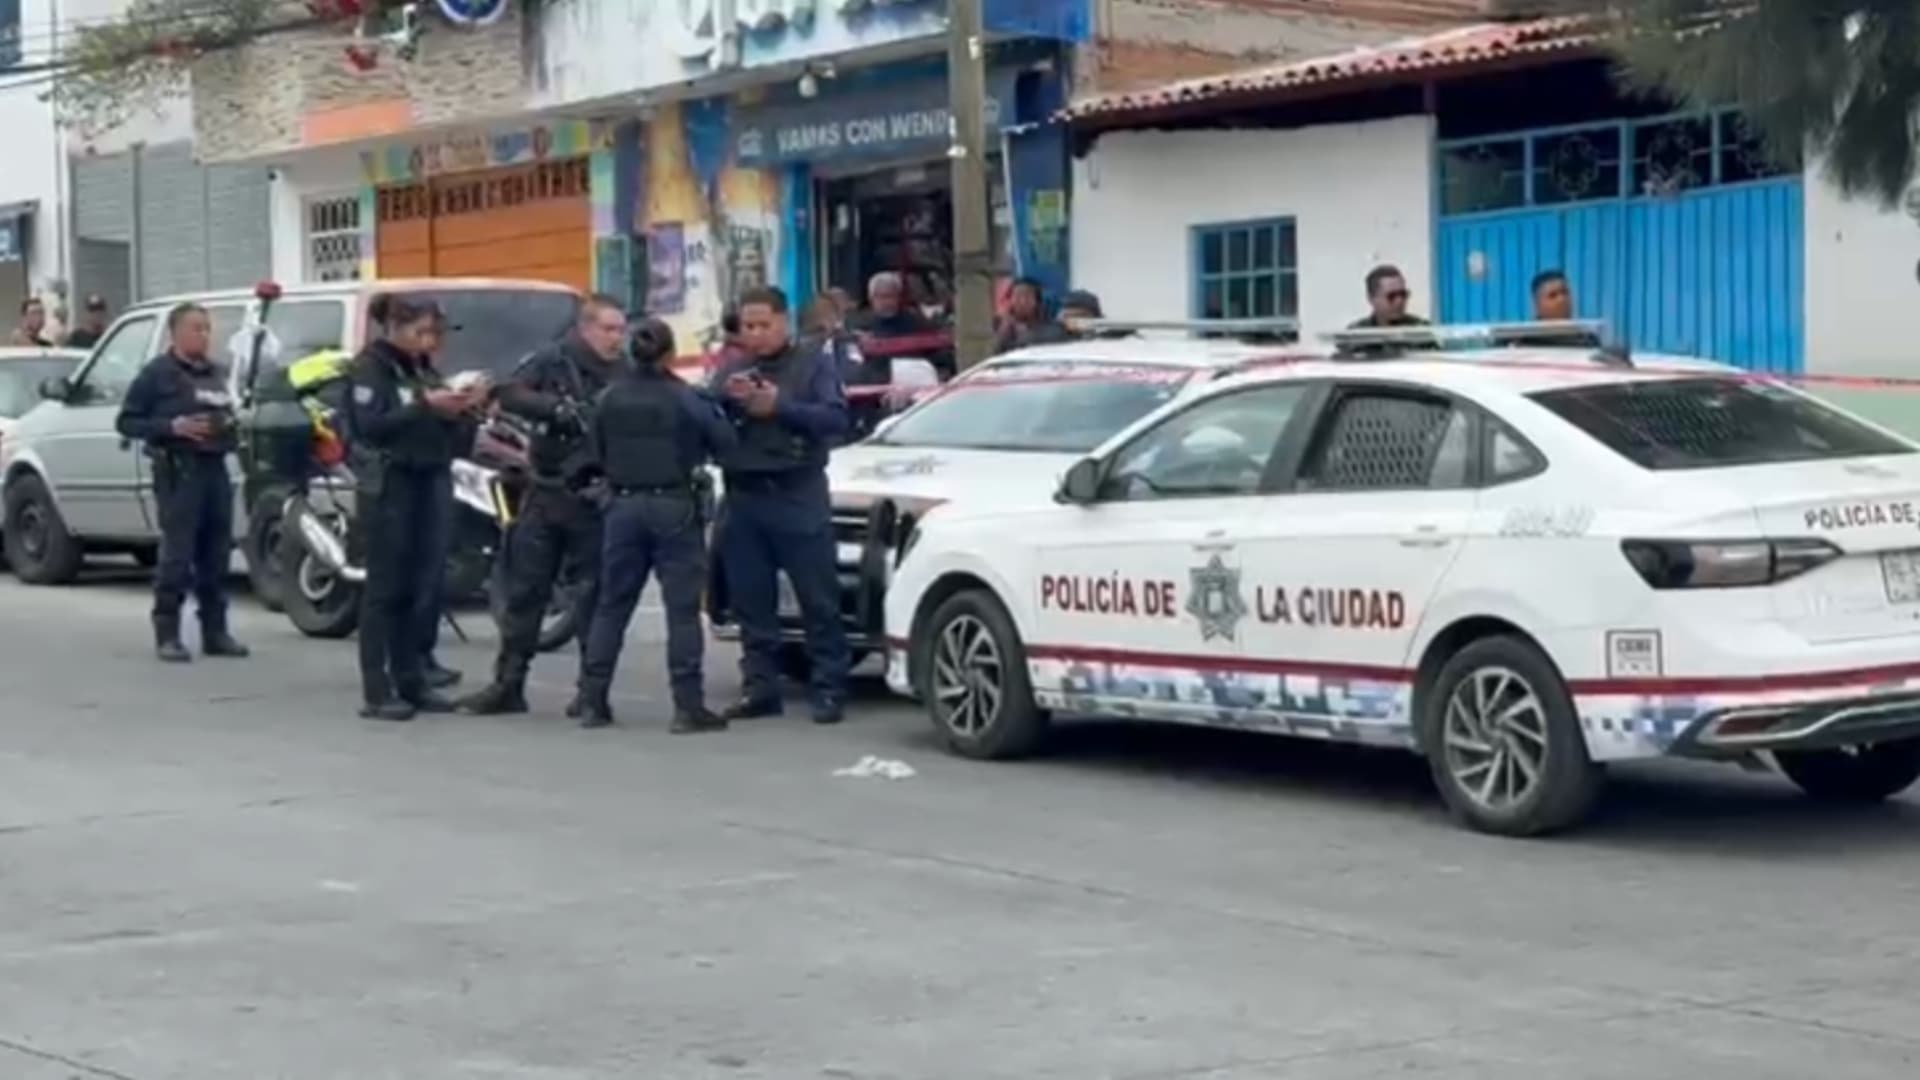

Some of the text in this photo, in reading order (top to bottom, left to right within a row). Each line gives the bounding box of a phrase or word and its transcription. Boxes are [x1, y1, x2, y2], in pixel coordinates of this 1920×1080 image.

[845, 119, 886, 145] CON
[1889, 502, 1916, 524] DE
[1041, 569, 1405, 629] POLICÍA DE LA CIUDAD
